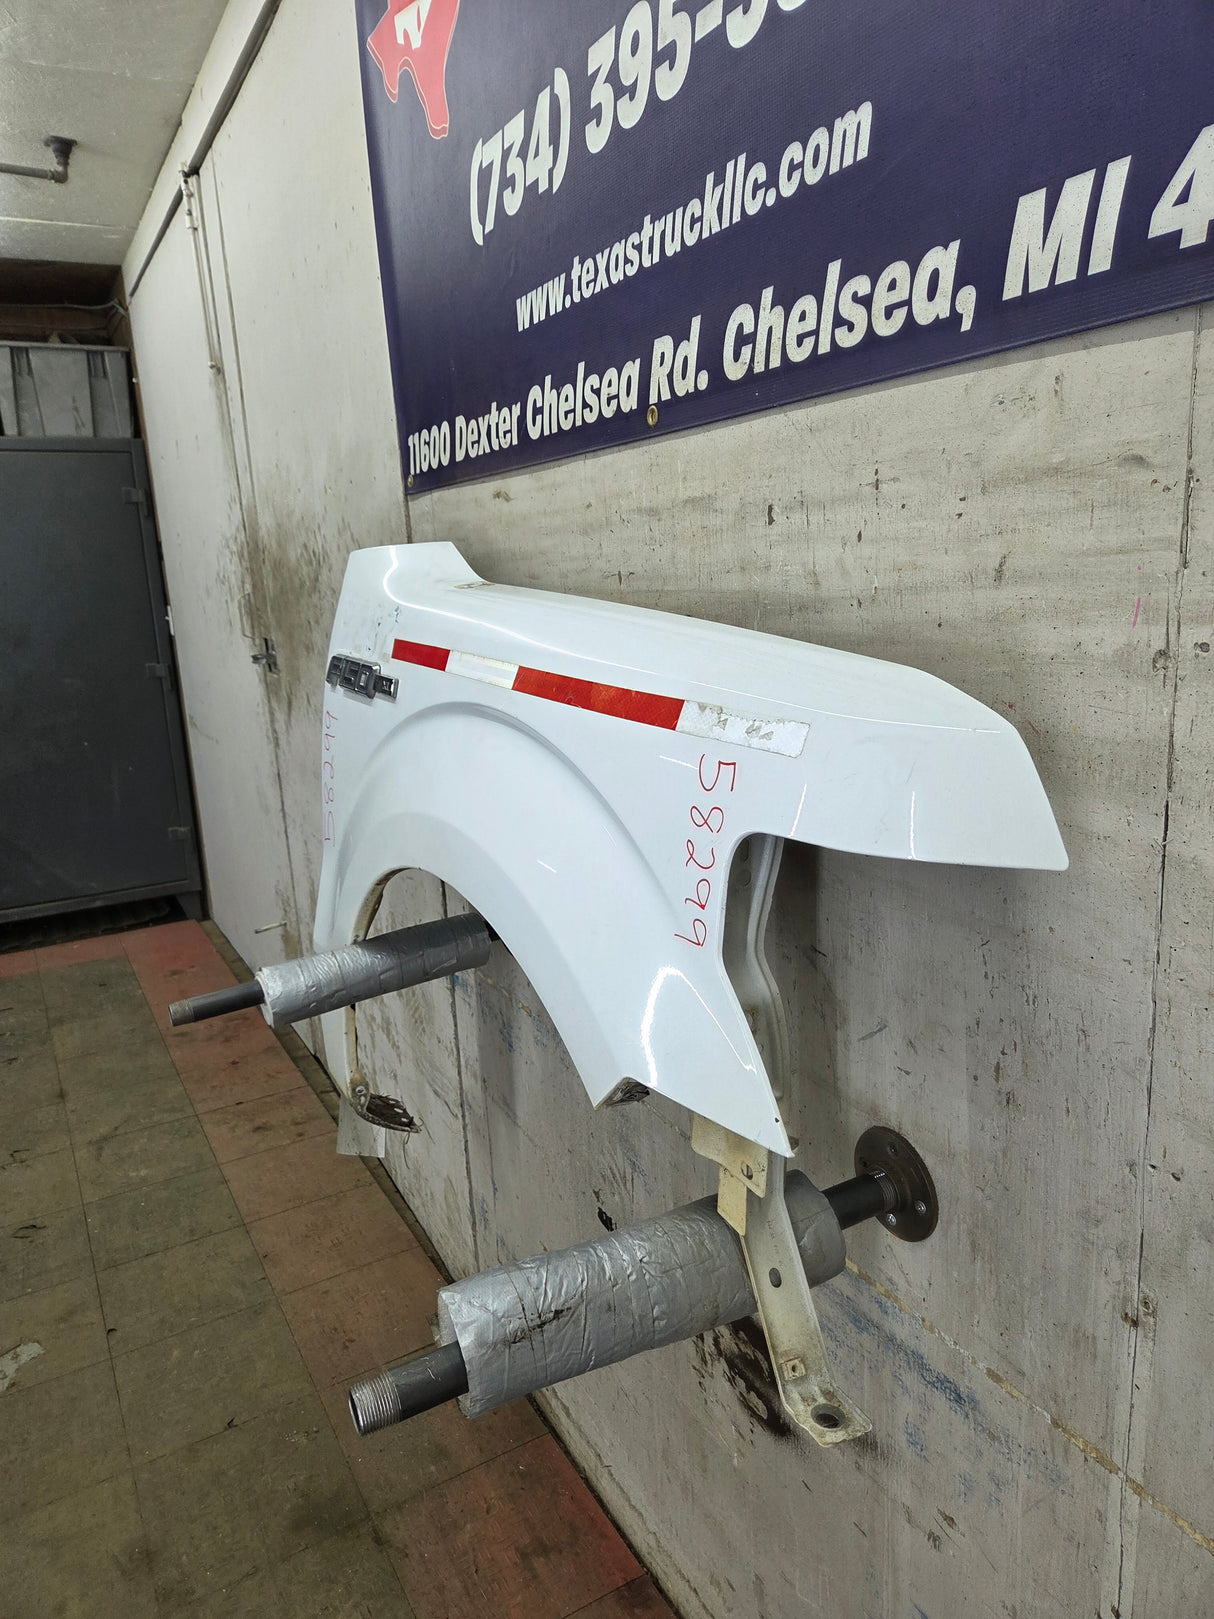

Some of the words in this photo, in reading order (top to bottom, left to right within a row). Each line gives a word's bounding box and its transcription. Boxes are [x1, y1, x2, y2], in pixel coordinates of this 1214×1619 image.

[469, 67, 571, 246] (734)
[584, 0, 807, 154] 395-
[515, 101, 873, 333] www.texastruckllc.com
[408, 420, 451, 475] 11600
[455, 402, 521, 462] Dexter
[526, 359, 641, 440] Chelsea
[648, 315, 709, 405] Rd.
[722, 239, 977, 381] Chelsea,
[1002, 155, 1132, 301] MI
[674, 753, 737, 948] 58299
